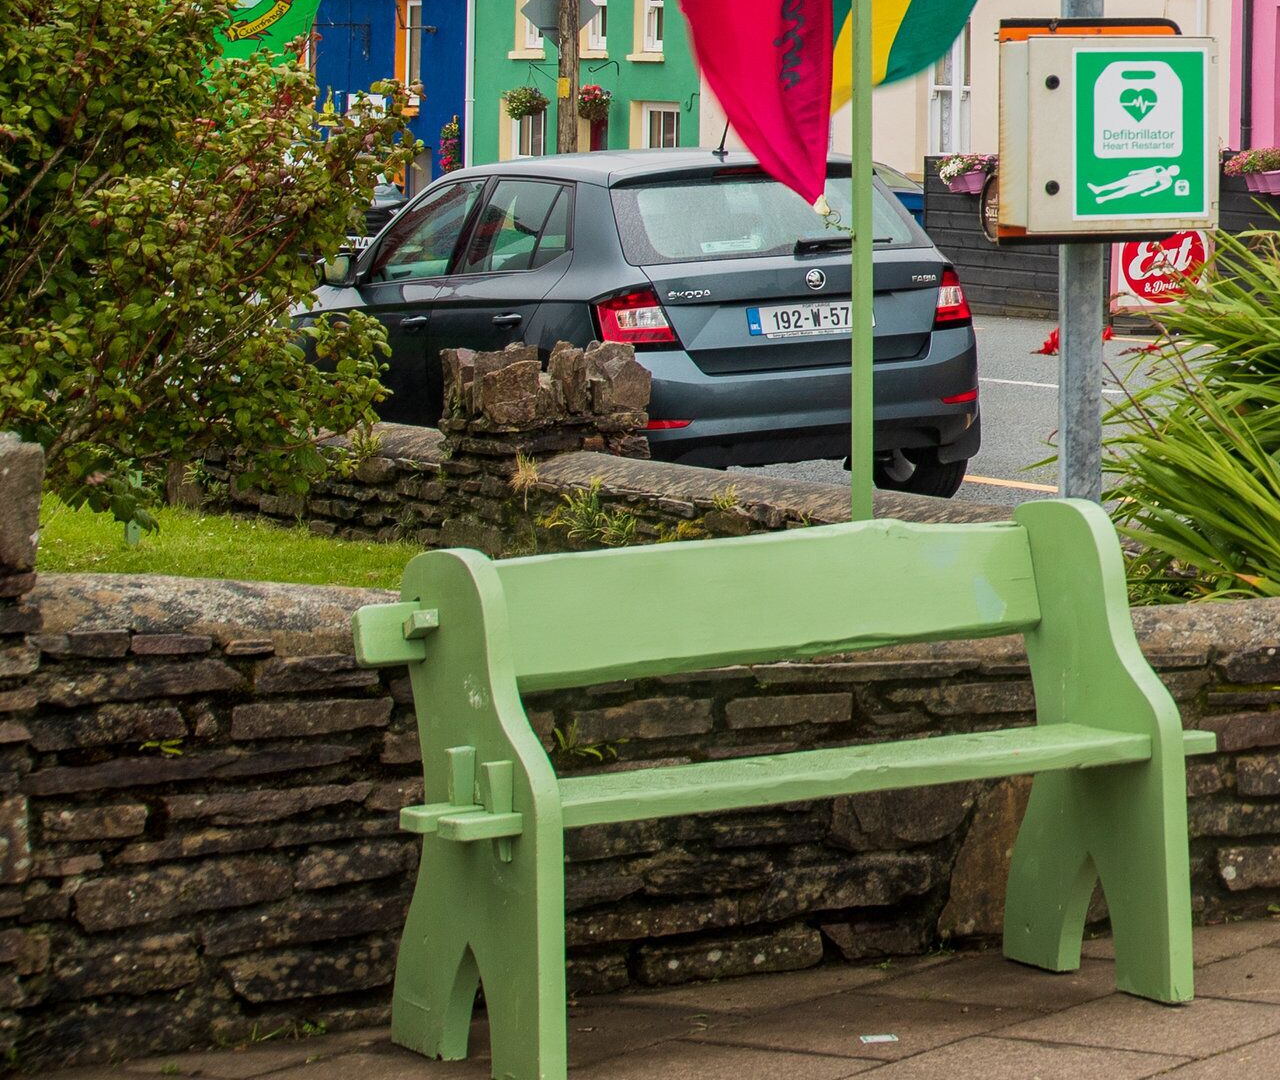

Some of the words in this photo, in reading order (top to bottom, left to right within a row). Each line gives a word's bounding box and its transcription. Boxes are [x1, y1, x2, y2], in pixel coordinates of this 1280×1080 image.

[1102, 129, 1174, 141] Defibrillator
[1103, 142, 1129, 150] Heart
[1131, 141, 1175, 150] Restarter
[1129, 236, 1193, 280] Eat
[911, 274, 937, 283] FABIA
[1144, 282, 1151, 292] &
